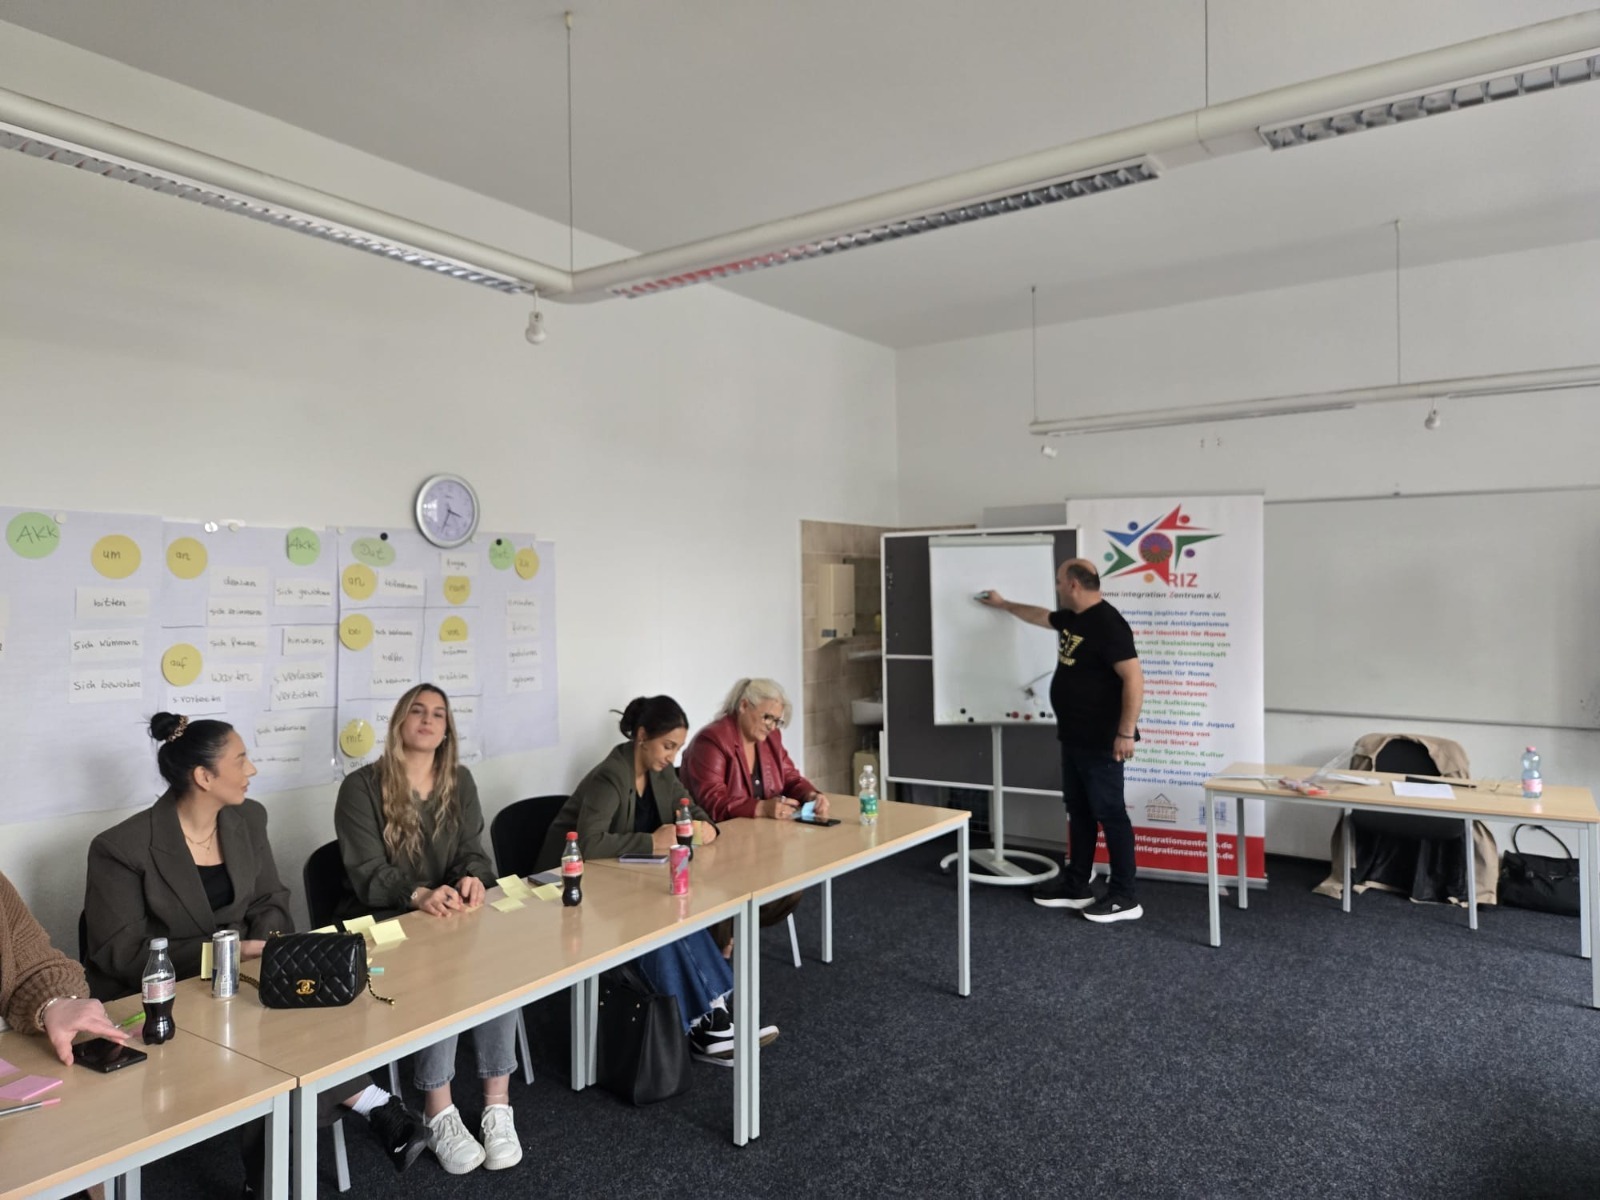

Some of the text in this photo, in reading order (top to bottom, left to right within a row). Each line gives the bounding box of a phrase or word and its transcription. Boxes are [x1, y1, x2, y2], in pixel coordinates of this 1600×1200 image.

[103, 550, 121, 559] um
[1168, 573, 1198, 588] RIZ
[1169, 591, 1205, 599] Zentrum
[170, 658, 188, 669] auf
[1191, 719, 1204, 727] die
[1169, 778, 1204, 787] Organisa
